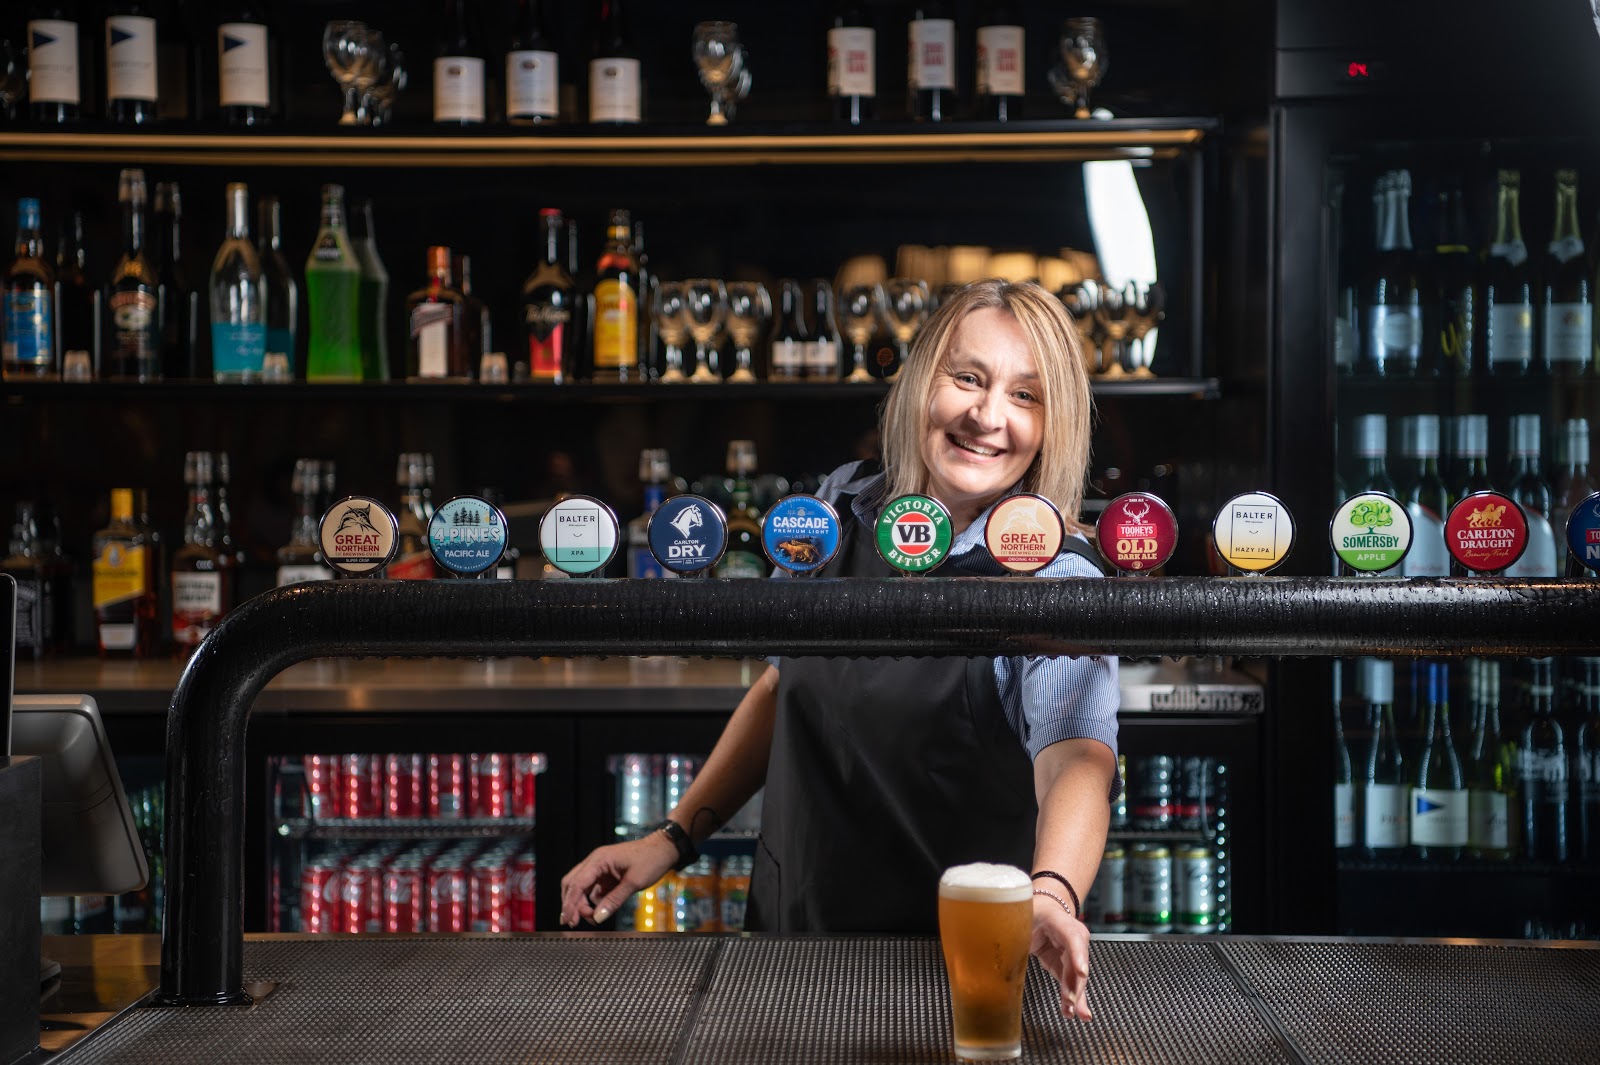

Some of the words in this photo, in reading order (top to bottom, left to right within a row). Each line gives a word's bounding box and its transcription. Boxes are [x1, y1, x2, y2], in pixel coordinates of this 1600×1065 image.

[883, 500, 943, 525] VICTORIA
[773, 516, 829, 529] CASCADE
[434, 527, 445, 543] 4
[449, 527, 500, 543] PINES
[896, 525, 931, 543] VB
[1121, 526, 1153, 535] TOOHEYS
[1457, 529, 1515, 539] CARLTON
[335, 535, 379, 544] GREAT
[1001, 534, 1045, 543] GREAT
[1343, 536, 1399, 548] SOMERSBY
[1460, 540, 1513, 548] DRAUGHT
[668, 544, 706, 558] DRY
[1117, 539, 1158, 553] OLD
[888, 548, 941, 567] BITTER
[1151, 685, 1244, 713] williams
